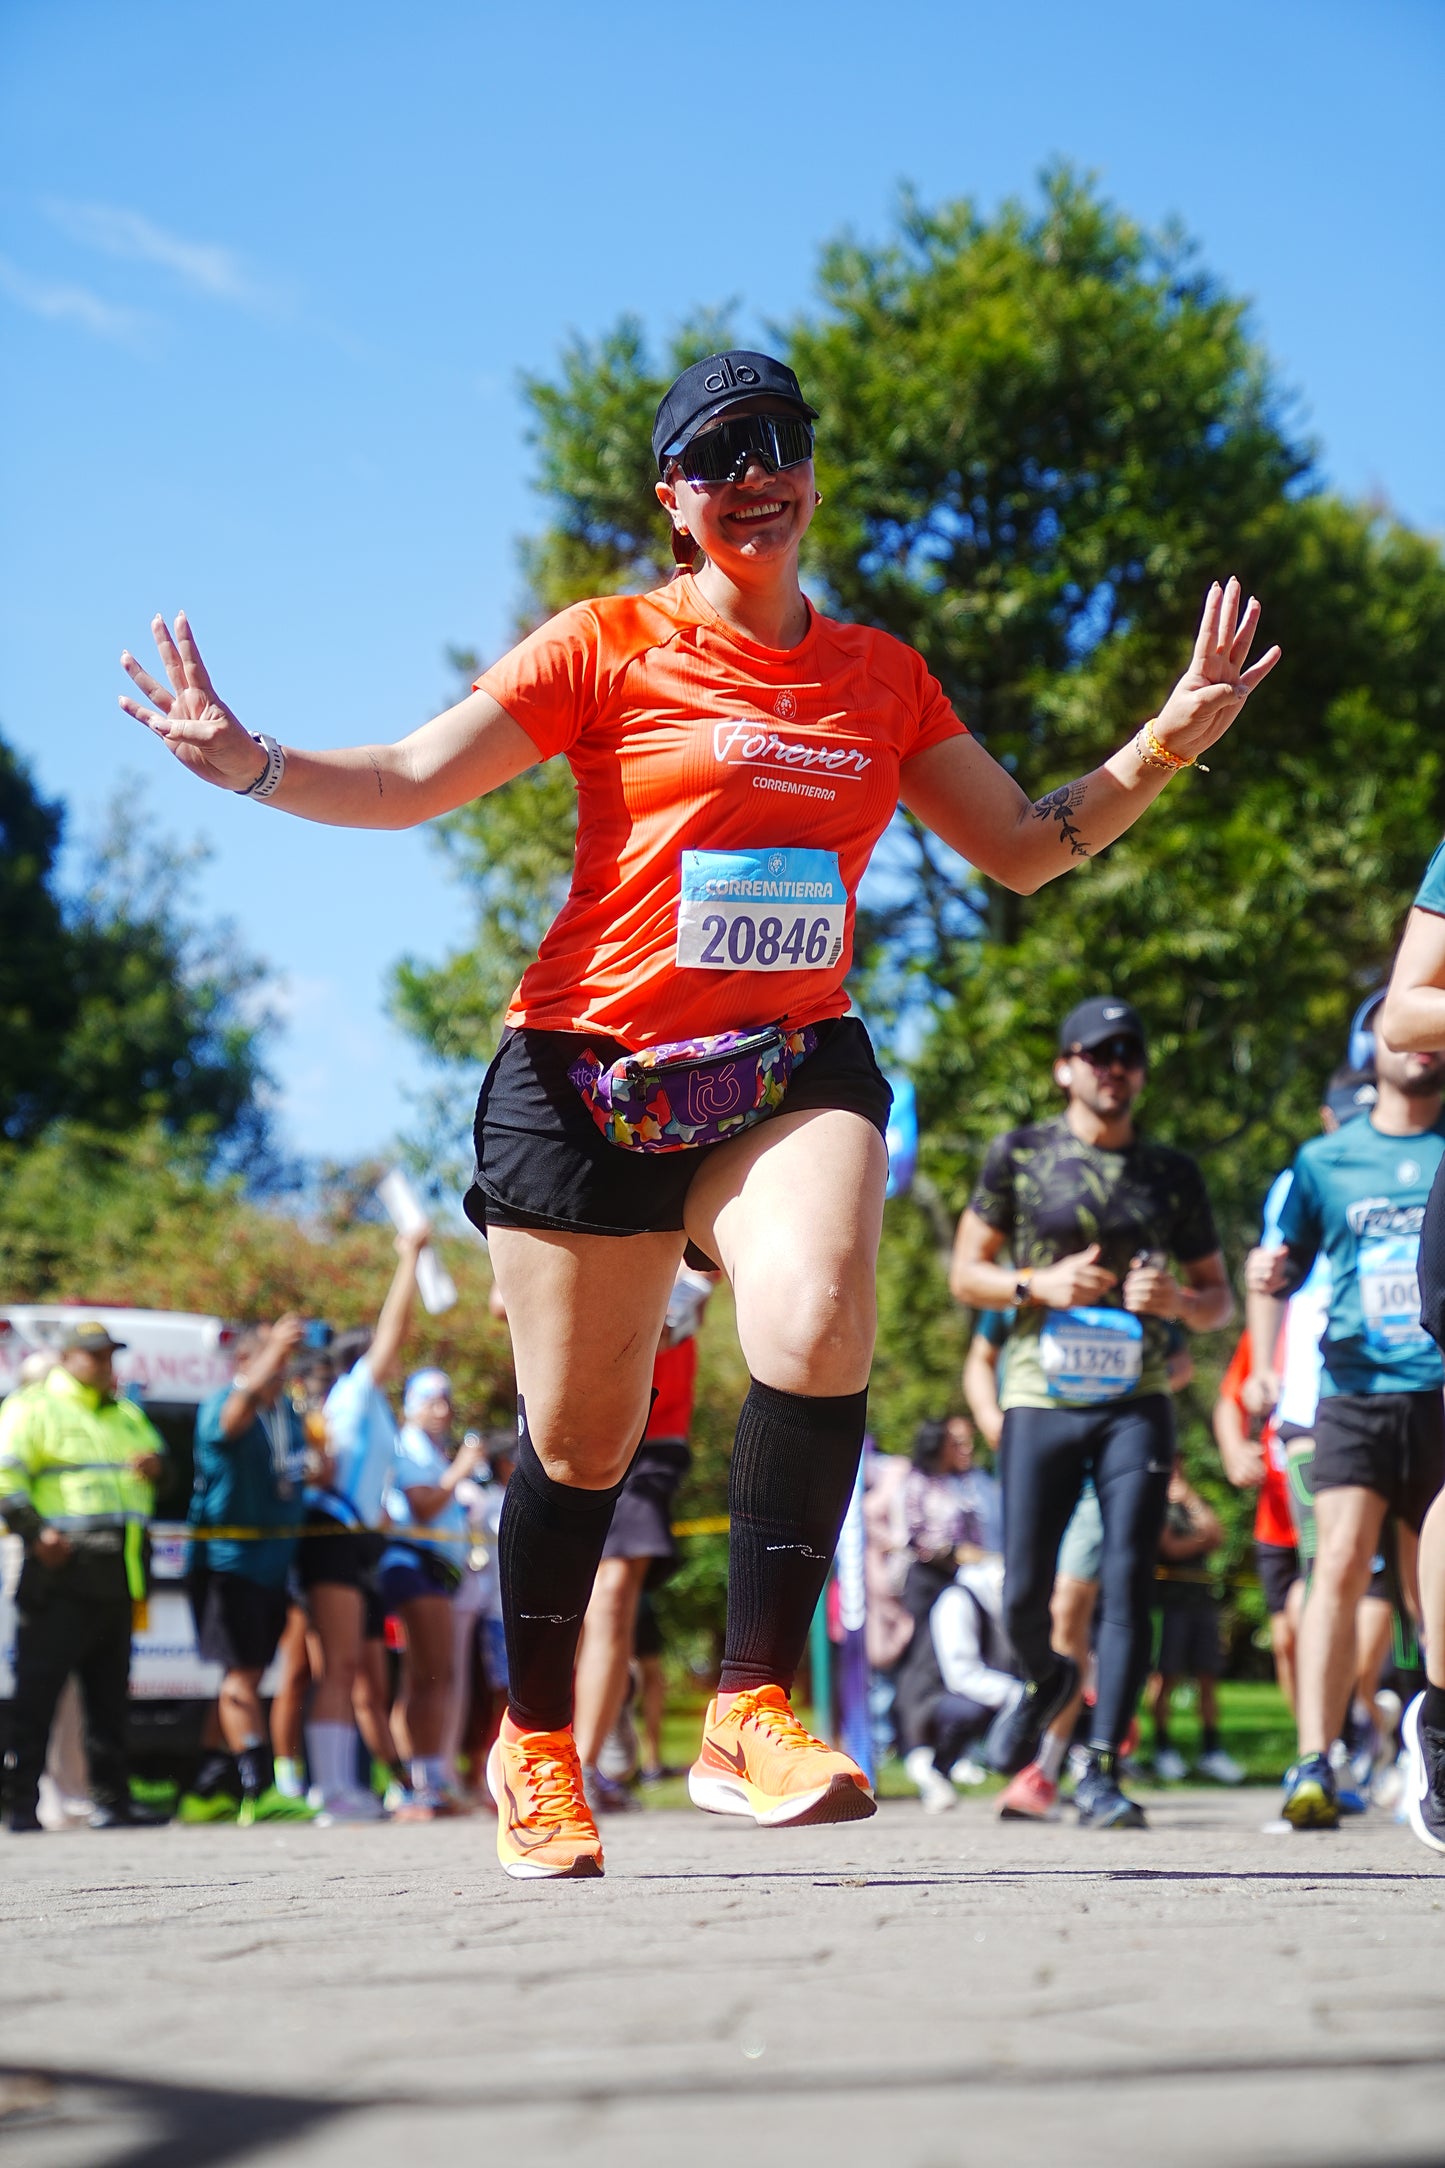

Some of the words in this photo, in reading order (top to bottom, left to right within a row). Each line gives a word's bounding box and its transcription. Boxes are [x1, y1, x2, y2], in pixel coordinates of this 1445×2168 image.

[704, 358, 760, 393] alo
[713, 717, 872, 772] Forever
[752, 776, 836, 801] CORREMITIERRA
[705, 878, 833, 898] CORREMITIERRA
[700, 914, 831, 966] 20846
